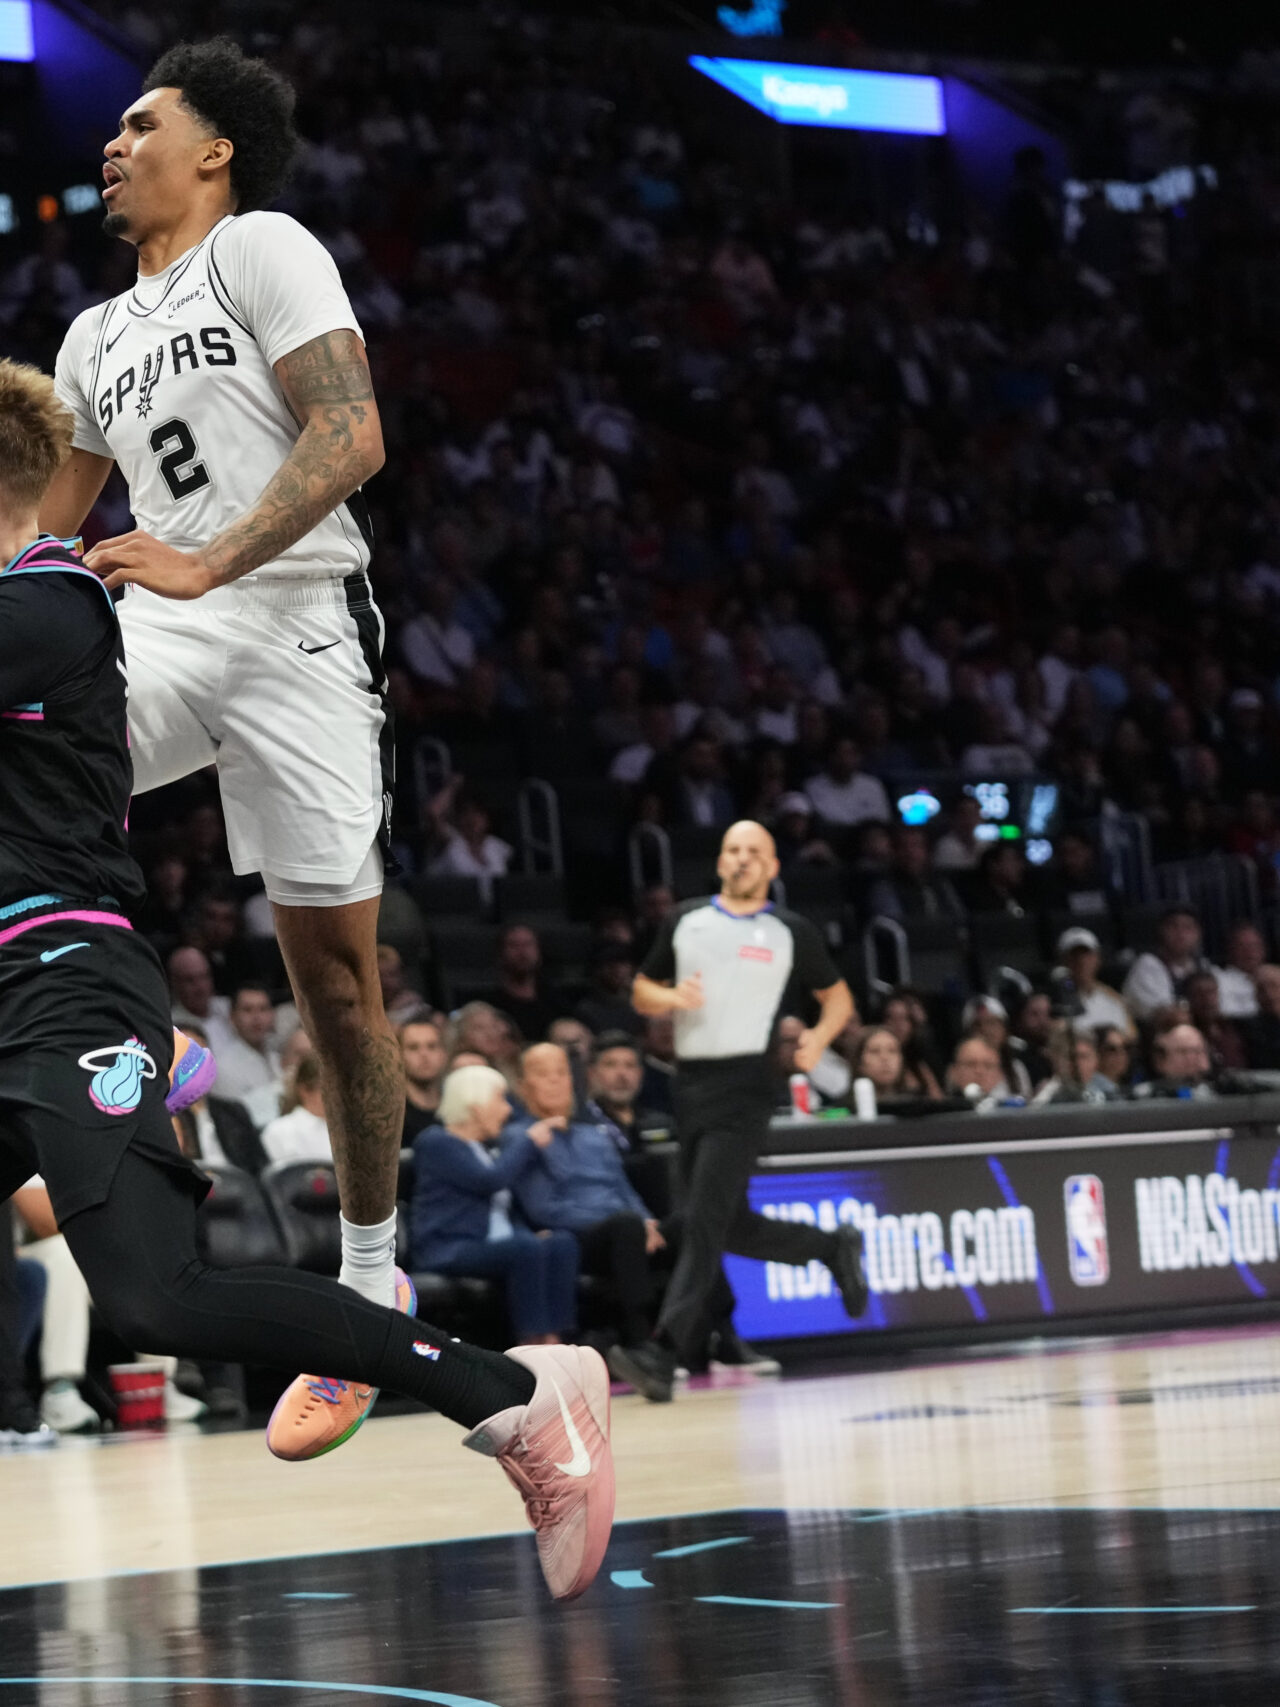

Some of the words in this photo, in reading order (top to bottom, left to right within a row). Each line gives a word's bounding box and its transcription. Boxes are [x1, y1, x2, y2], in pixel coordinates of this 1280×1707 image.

[173, 290, 200, 311] LEDGER
[98, 327, 237, 436] SPURS
[148, 416, 213, 503] 2
